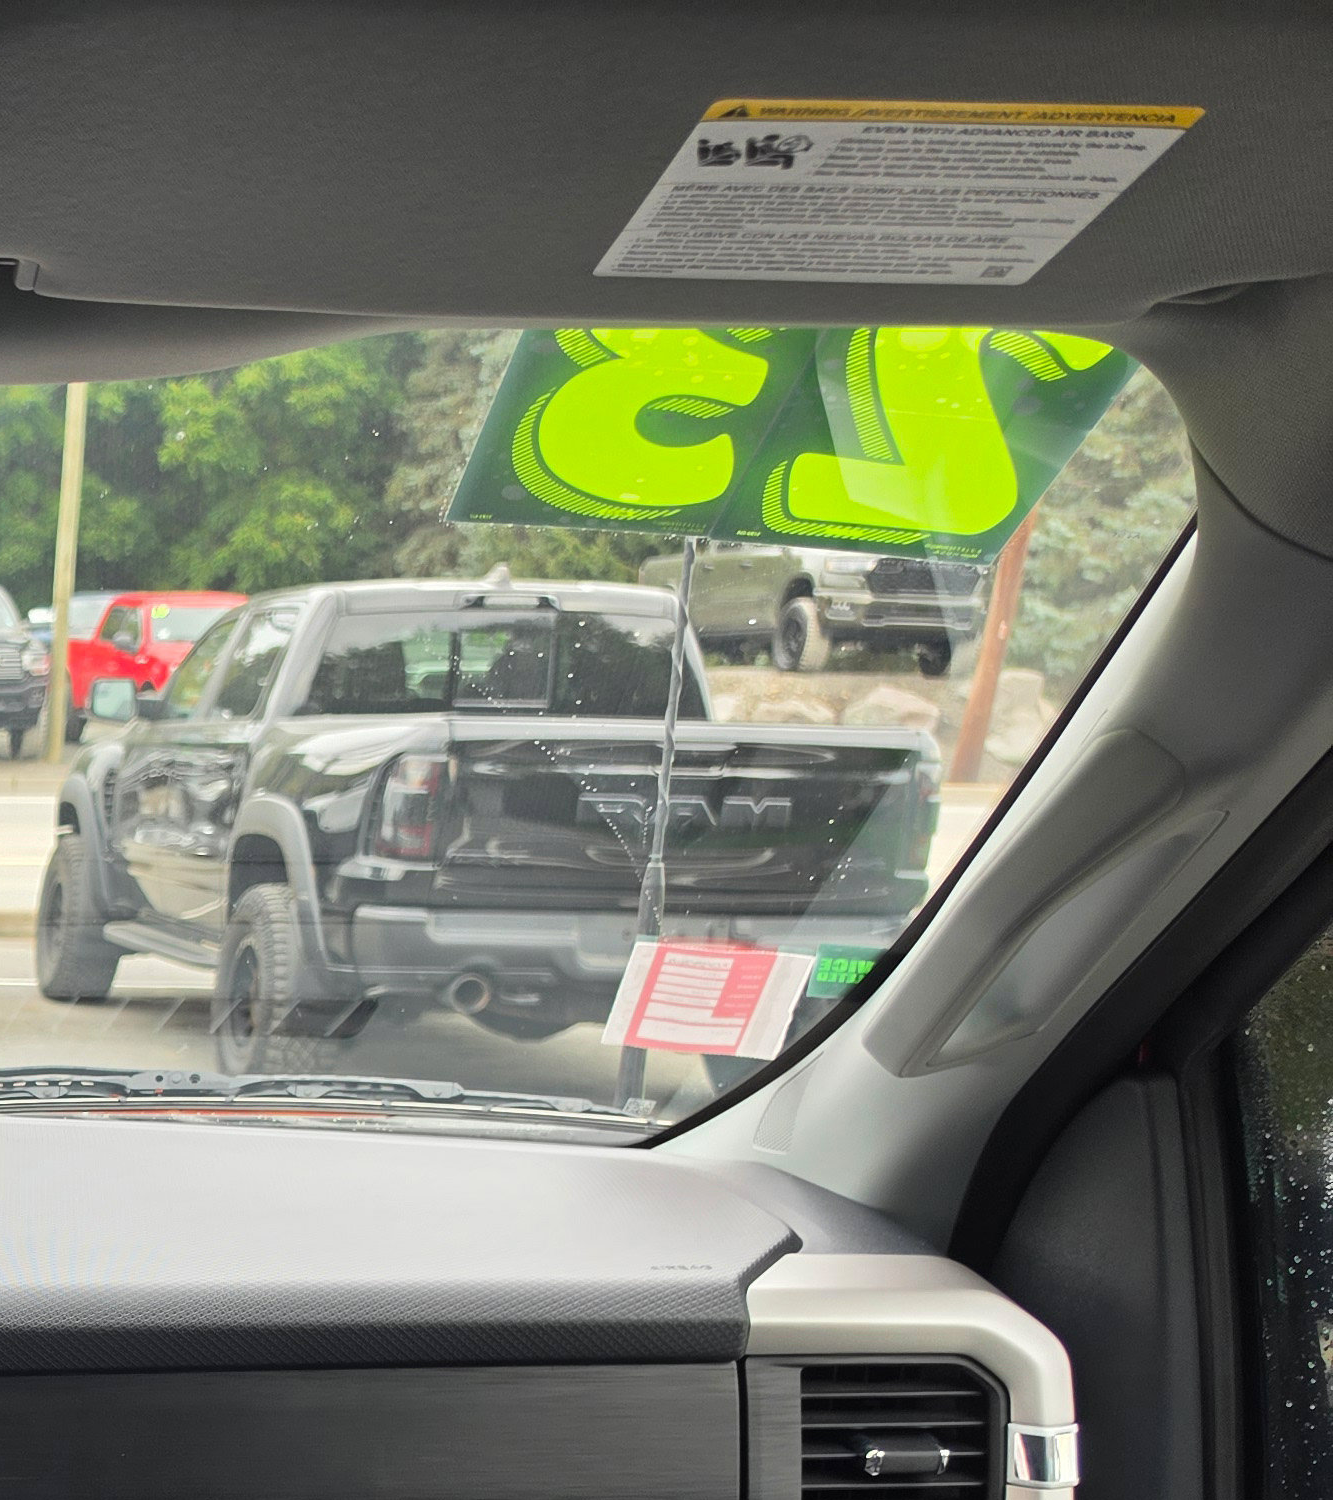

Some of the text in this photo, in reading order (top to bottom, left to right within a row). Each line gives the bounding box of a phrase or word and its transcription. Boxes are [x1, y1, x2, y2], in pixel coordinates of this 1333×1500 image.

[860, 125, 1139, 139] EVEN WITH ADVANCED AIR BAGS
